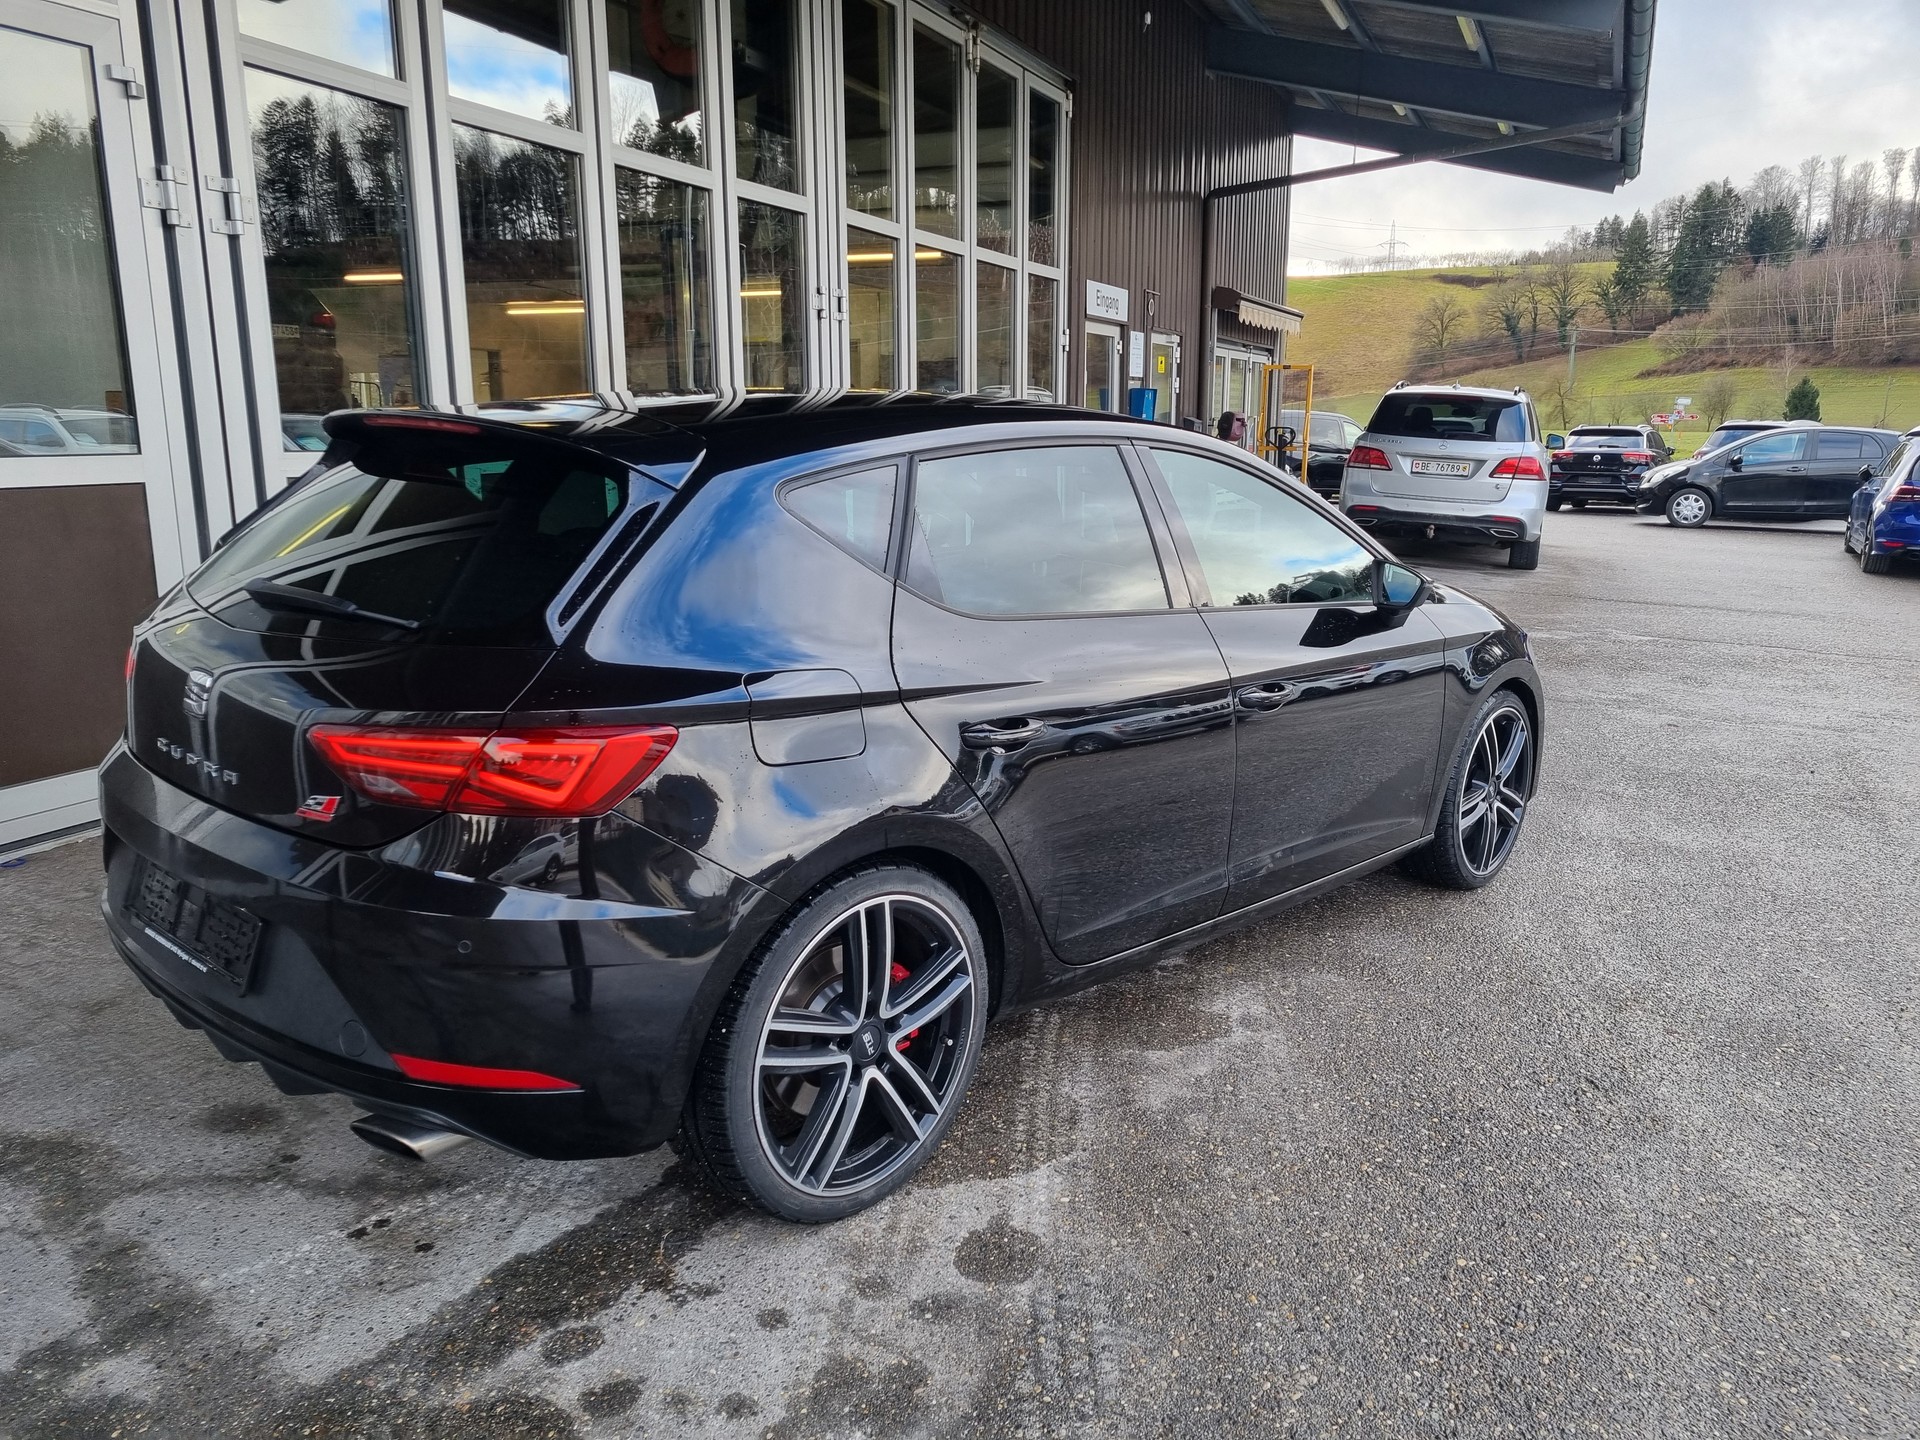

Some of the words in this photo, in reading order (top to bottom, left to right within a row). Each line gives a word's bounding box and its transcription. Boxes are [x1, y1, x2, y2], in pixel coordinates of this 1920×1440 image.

[1096, 289, 1119, 315] Eingang
[1435, 463, 1460, 473] 76789
[157, 738, 239, 785] CUPRA
